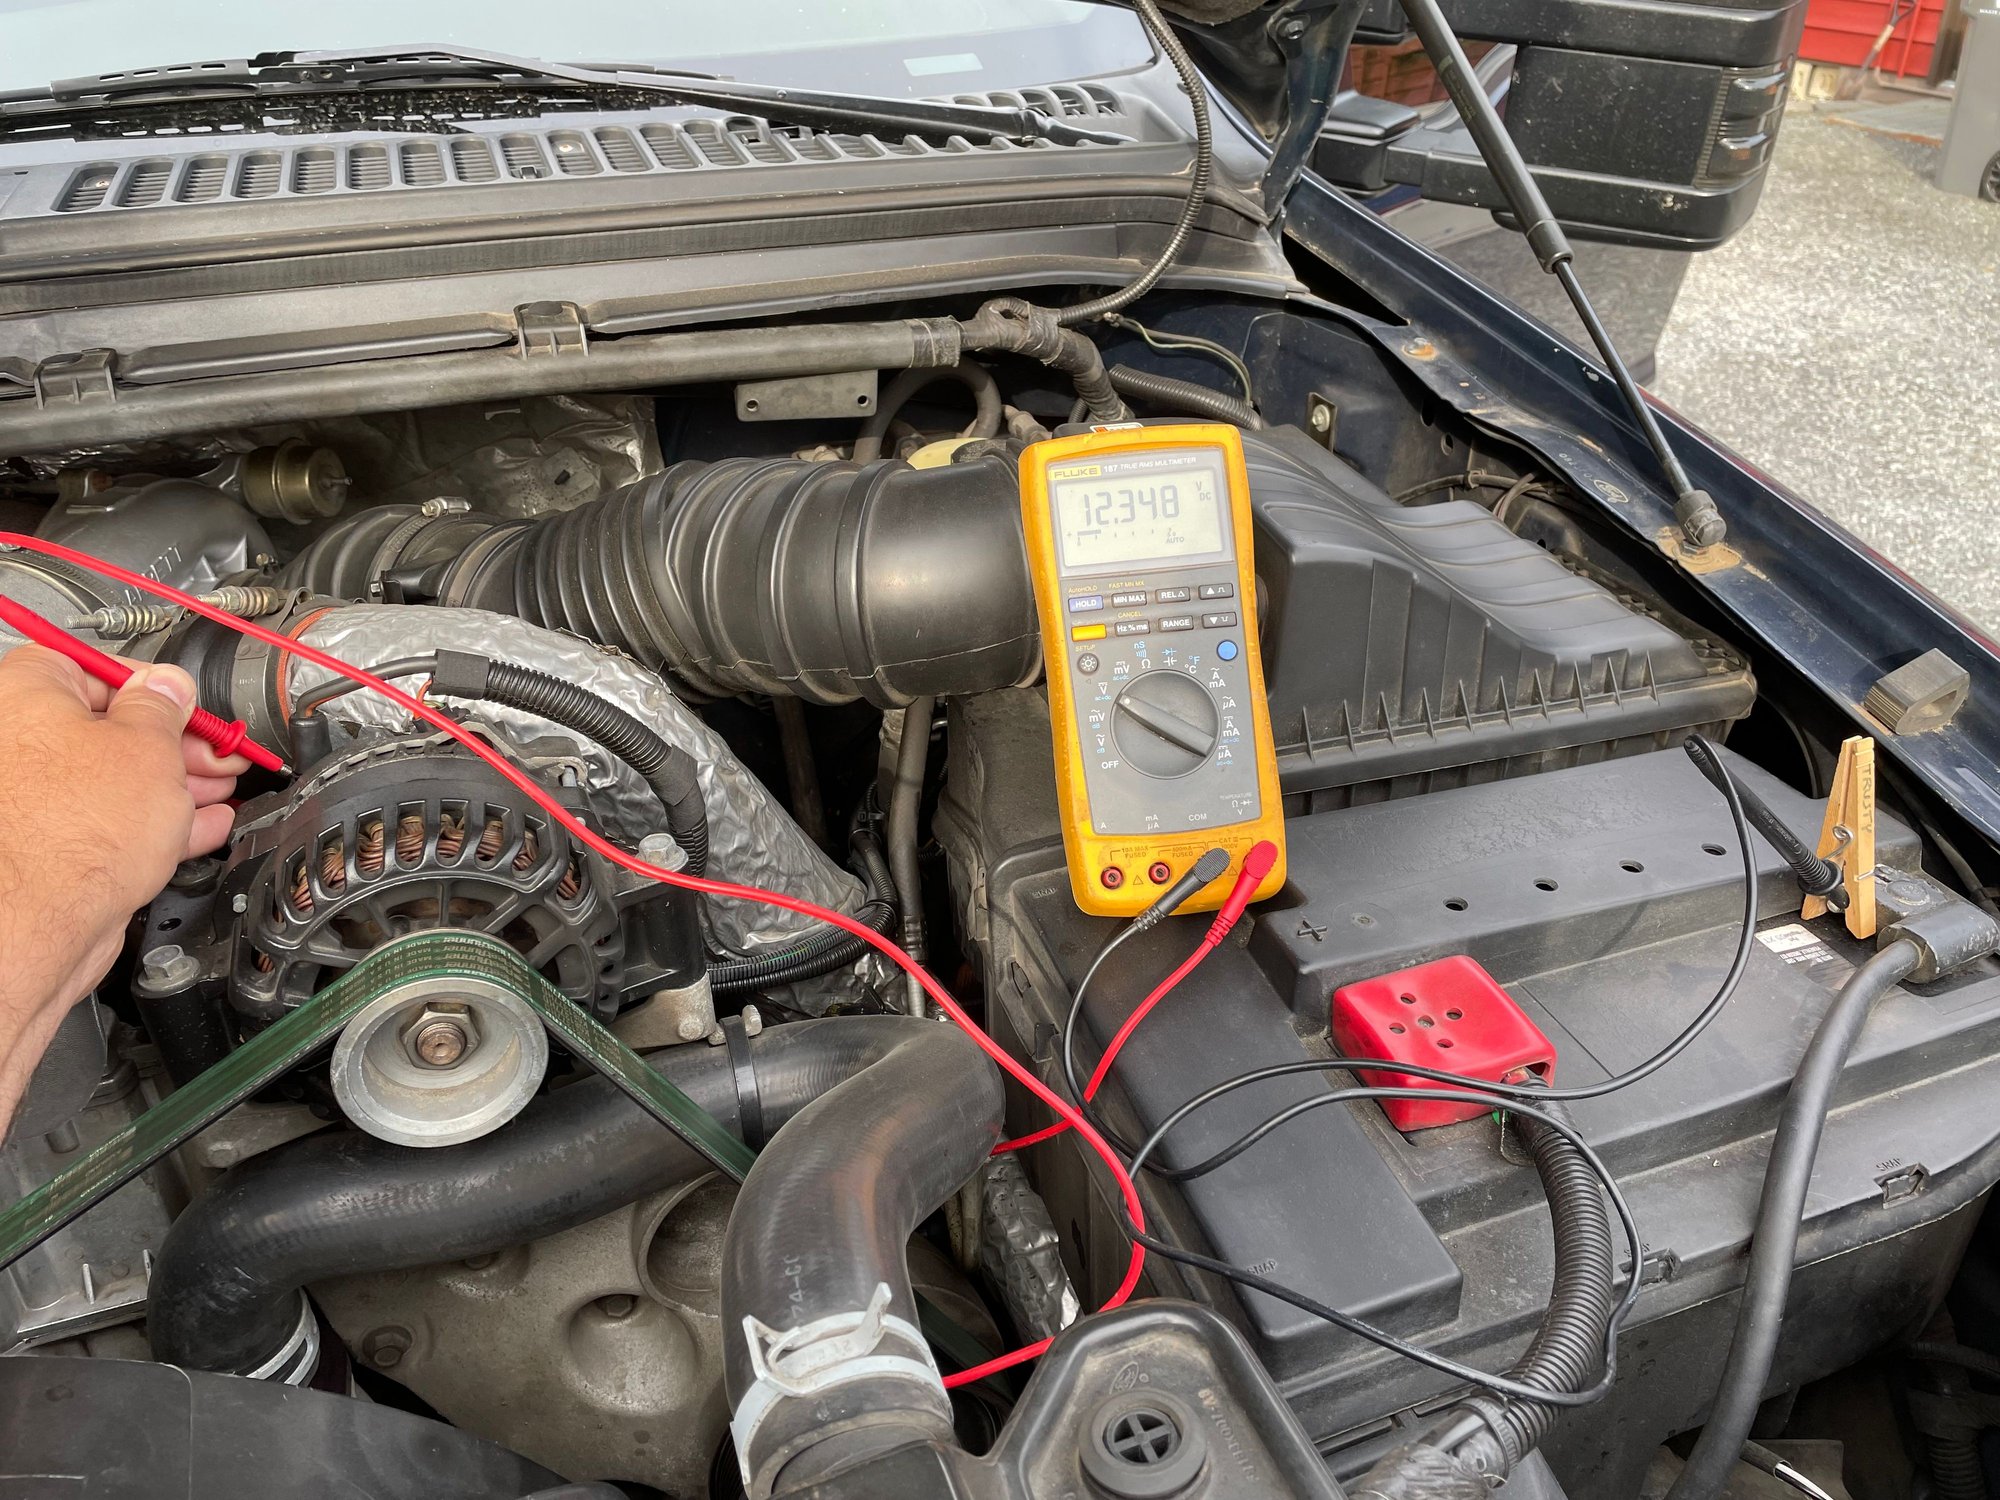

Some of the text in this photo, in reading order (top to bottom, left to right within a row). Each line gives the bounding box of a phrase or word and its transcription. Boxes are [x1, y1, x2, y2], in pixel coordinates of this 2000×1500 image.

[1053, 467, 1098, 478] FLUKE
[1104, 464, 1118, 472] 187
[1120, 462, 1137, 470] TRUE
[1155, 457, 1197, 467] MULTIMETER
[1196, 481, 1202, 491] V
[1200, 492, 1212, 501] DC
[1084, 485, 1180, 526] 12.348
[1166, 536, 1185, 544] AUTO
[1068, 585, 1098, 593] AutoHOLD
[1113, 594, 1146, 604] MIN MAX
[1161, 591, 1177, 599] REL
[1075, 599, 1097, 608] HOLD
[1162, 618, 1190, 627] RANGE
[1116, 625, 1127, 633] Hz
[1136, 623, 1148, 631] ms
[1075, 644, 1096, 652] SETUP
[1134, 641, 1146, 649] nS
[1114, 665, 1130, 675] mV
[1212, 672, 1220, 680] A
[1209, 680, 1226, 689] mA
[1100, 685, 1107, 695] V
[1089, 713, 1105, 723] mV
[1226, 720, 1234, 729] A
[1223, 728, 1240, 737] mA
[1097, 738, 1105, 747] V
[1101, 761, 1119, 769] OFF
[1862, 763, 1874, 834] TRUSTY
[1188, 813, 1208, 822] COM
[405, 938, 431, 950] MADE
[406, 947, 431, 957] MADE
[406, 955, 432, 965] MADE
